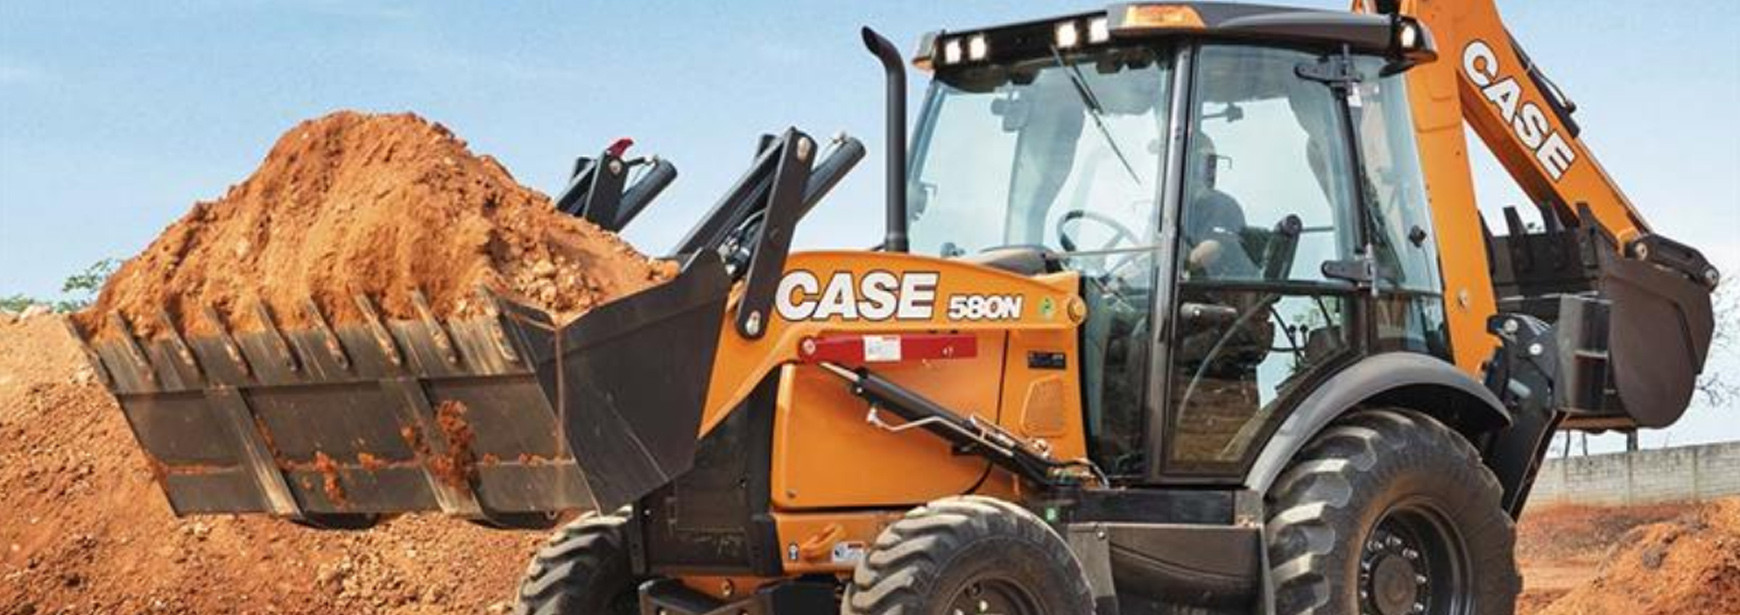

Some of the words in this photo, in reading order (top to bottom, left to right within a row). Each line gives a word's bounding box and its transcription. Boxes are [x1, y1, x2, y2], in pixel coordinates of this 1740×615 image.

[1462, 39, 1576, 181] CASE
[775, 270, 939, 321] CASE
[948, 294, 1022, 320] 580N
